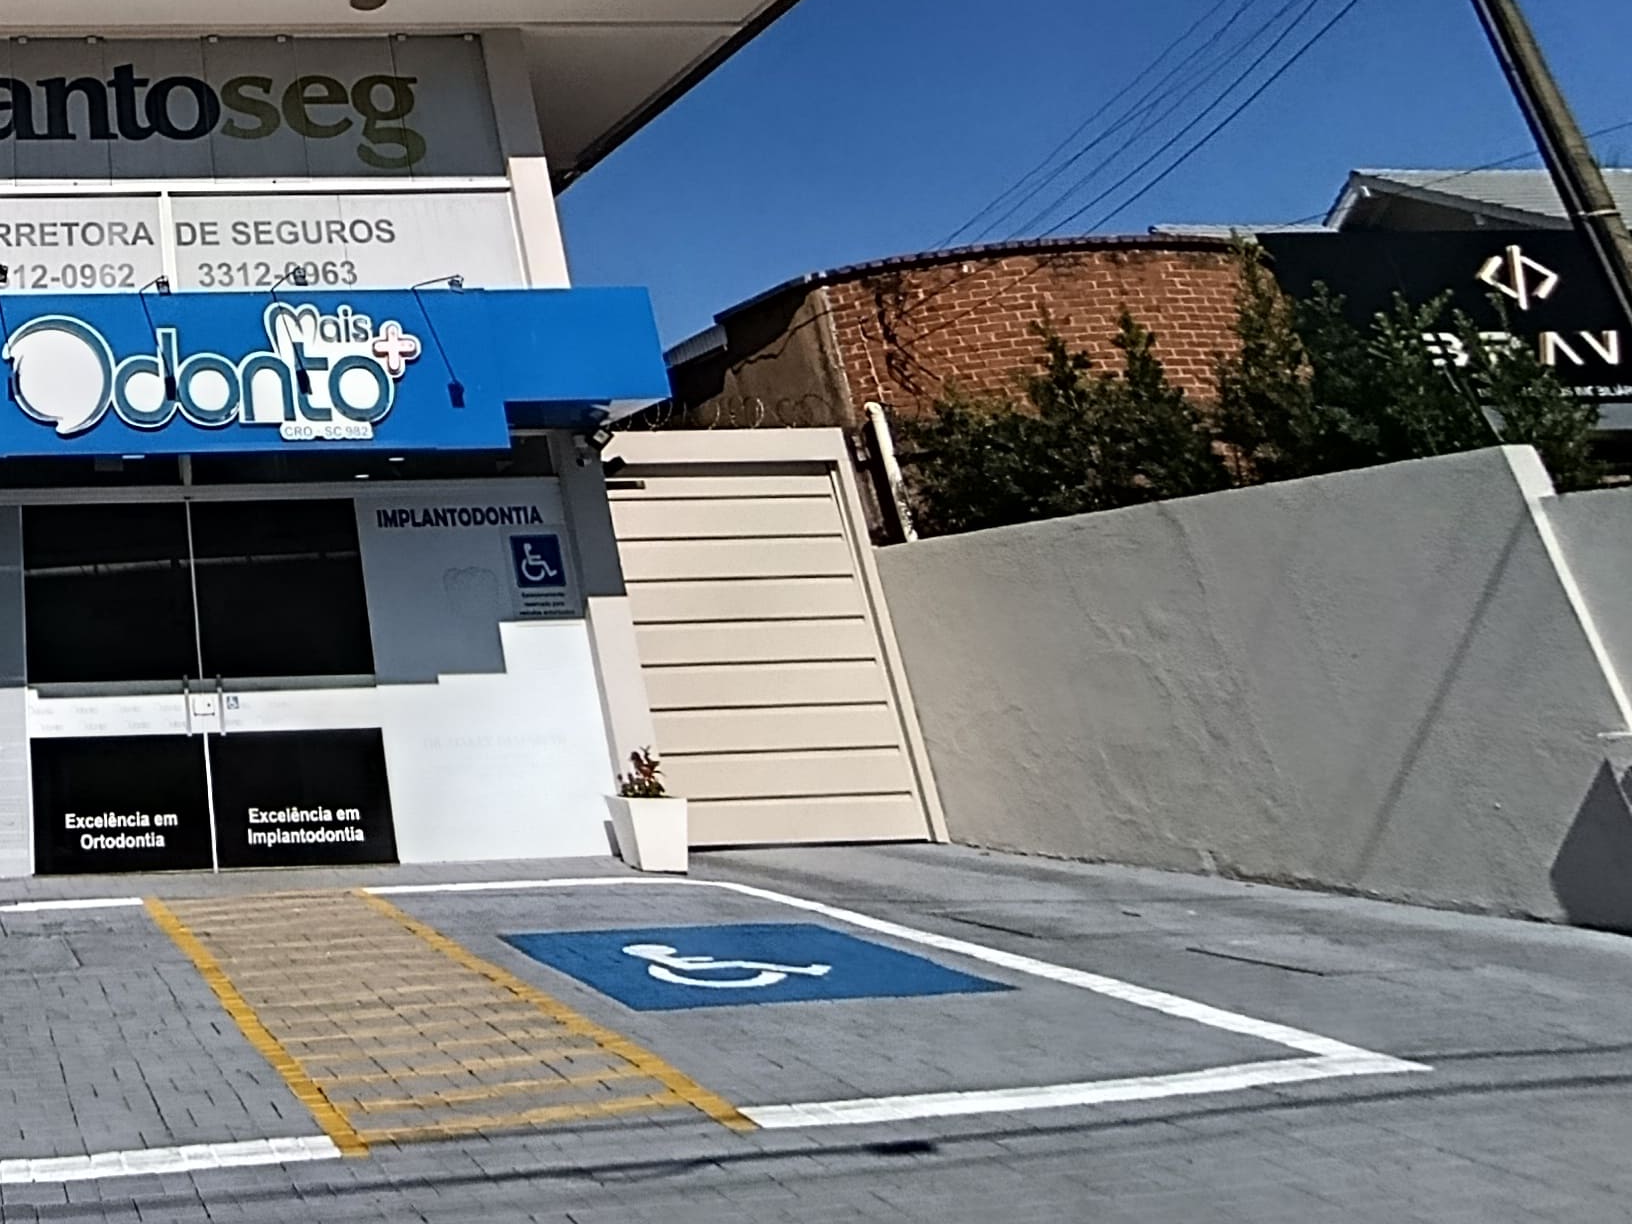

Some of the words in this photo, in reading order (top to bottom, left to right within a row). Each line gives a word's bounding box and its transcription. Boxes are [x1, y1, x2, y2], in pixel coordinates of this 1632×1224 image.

[175, 221, 220, 247] DE
[232, 218, 397, 246] SEGUROS
[198, 260, 358, 288] 3312-0963
[264, 303, 371, 349] Mais
[6, 315, 392, 432] Odonto
[284, 426, 313, 437] CRO
[324, 426, 342, 437] SC
[376, 506, 544, 528] IMPLANTODONTIA
[65, 812, 150, 830] Excelência
[154, 813, 178, 827] em
[248, 806, 332, 824] Excelência
[336, 807, 361, 822] em
[80, 832, 166, 850] Ortodontia
[247, 827, 365, 848] Implantodontia
